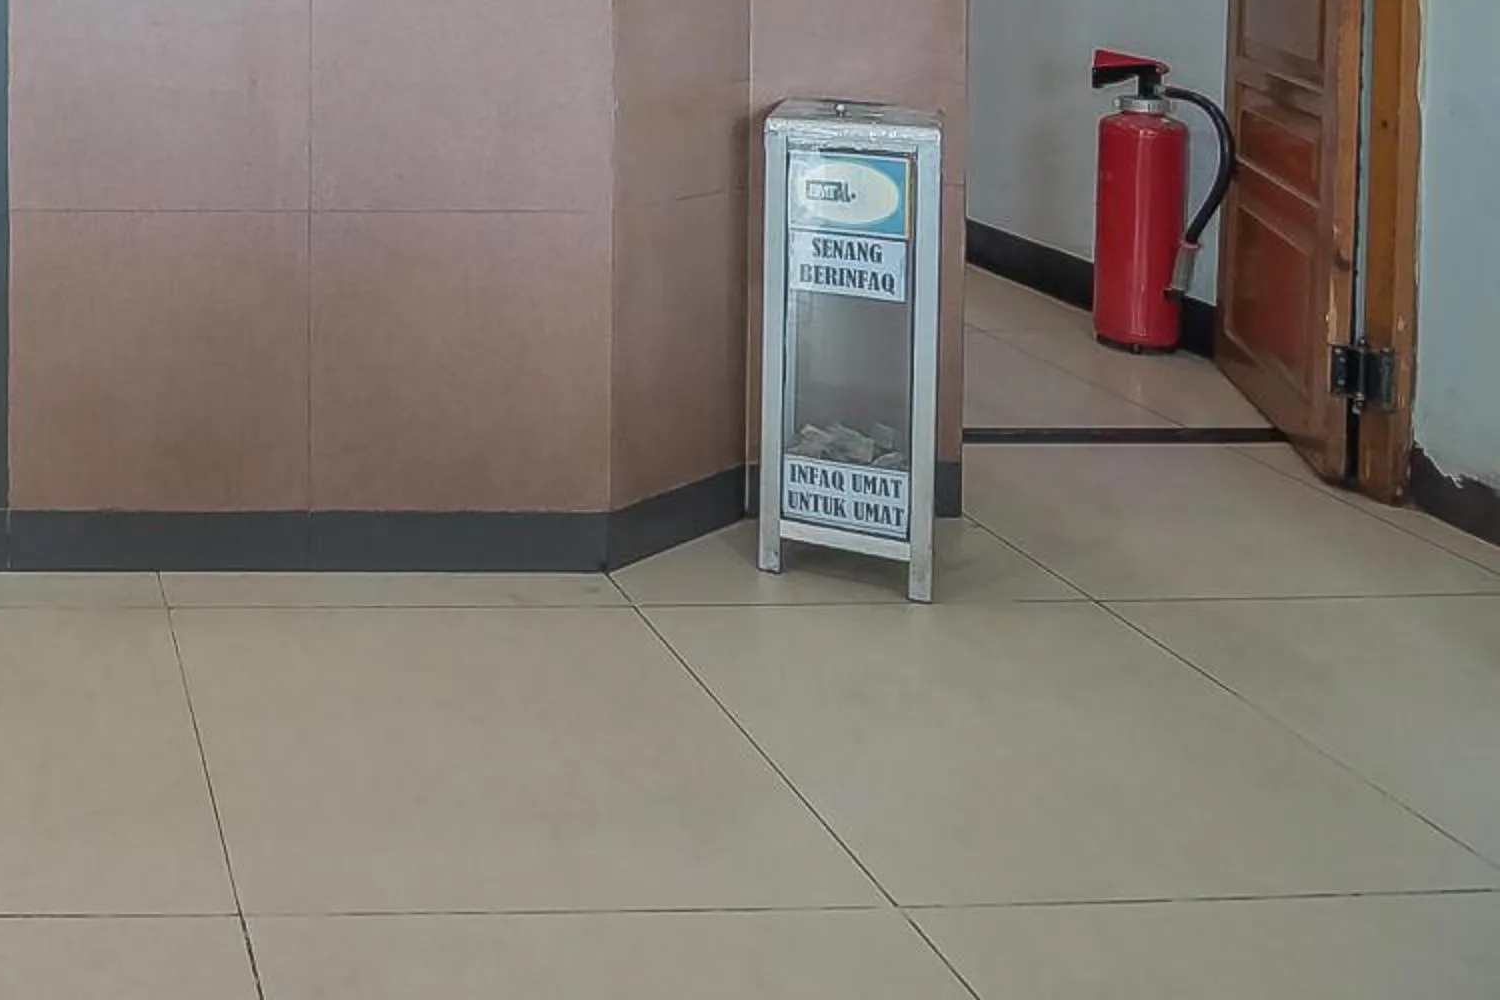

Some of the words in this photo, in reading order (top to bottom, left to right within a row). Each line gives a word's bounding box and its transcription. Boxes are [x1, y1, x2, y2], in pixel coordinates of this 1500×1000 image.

[811, 236, 883, 264] SENANG
[799, 263, 896, 295] BERINFAQ
[789, 463, 845, 493] INFAQ
[851, 473, 903, 499] UMAT
[787, 490, 847, 519] UNTUK
[854, 501, 905, 527] UMAT
